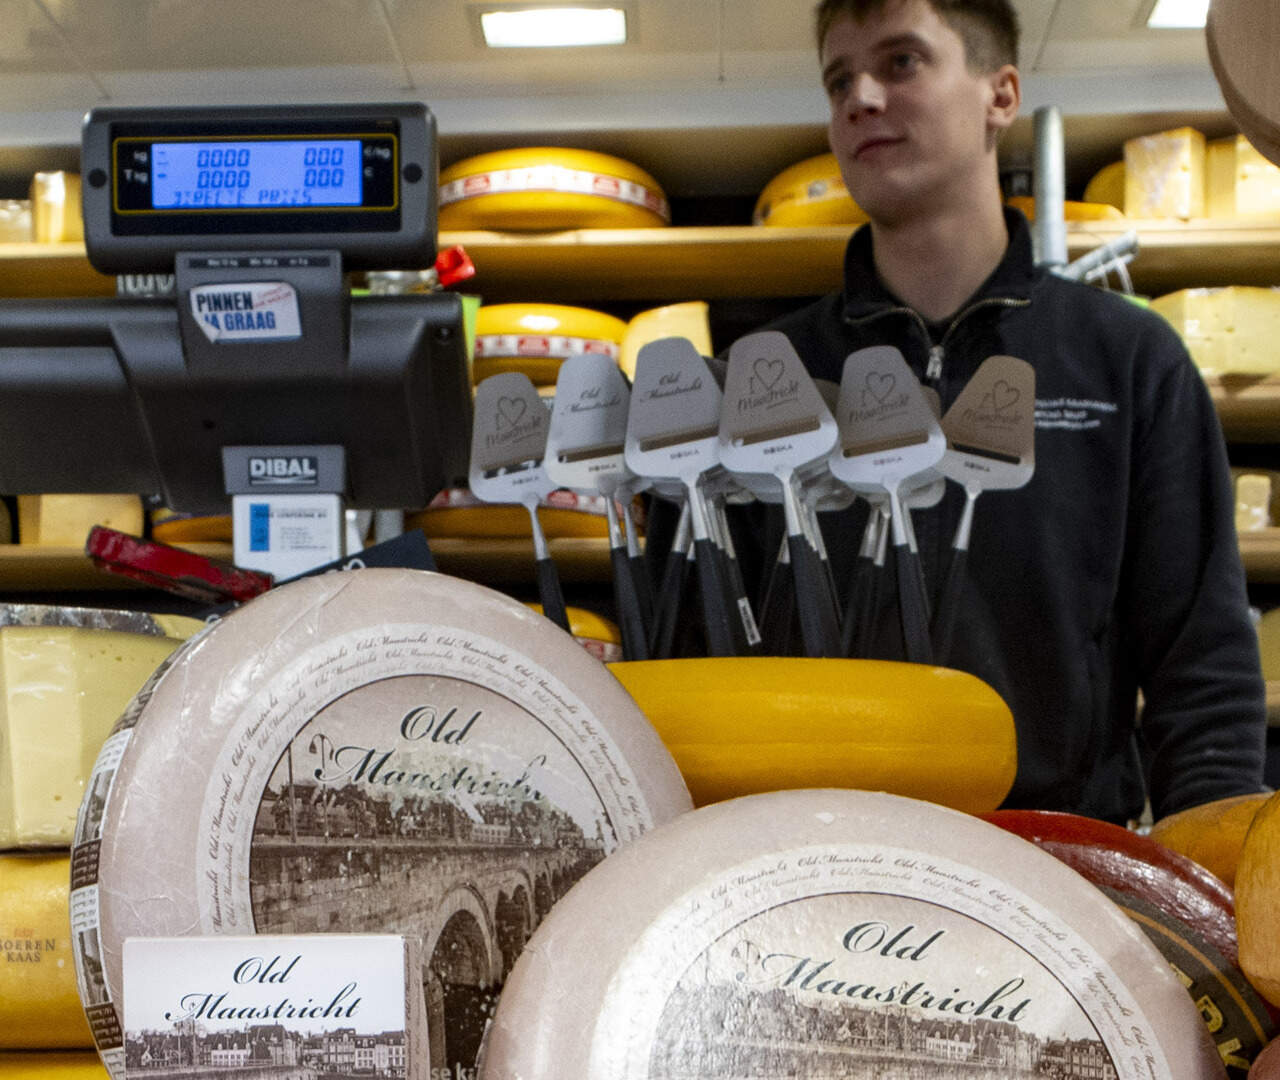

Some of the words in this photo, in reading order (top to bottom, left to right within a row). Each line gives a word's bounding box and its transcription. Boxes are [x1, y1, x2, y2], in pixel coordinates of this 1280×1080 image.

[196, 291, 254, 312] PINNEN
[224, 311, 277, 331] GRAAG
[250, 458, 317, 477] DIBAL
[400, 705, 483, 746] Old
[842, 920, 946, 963] Old
[233, 954, 303, 985] Old
[164, 981, 363, 1021] Maastricht
[735, 952, 1034, 1024] Maastricht
